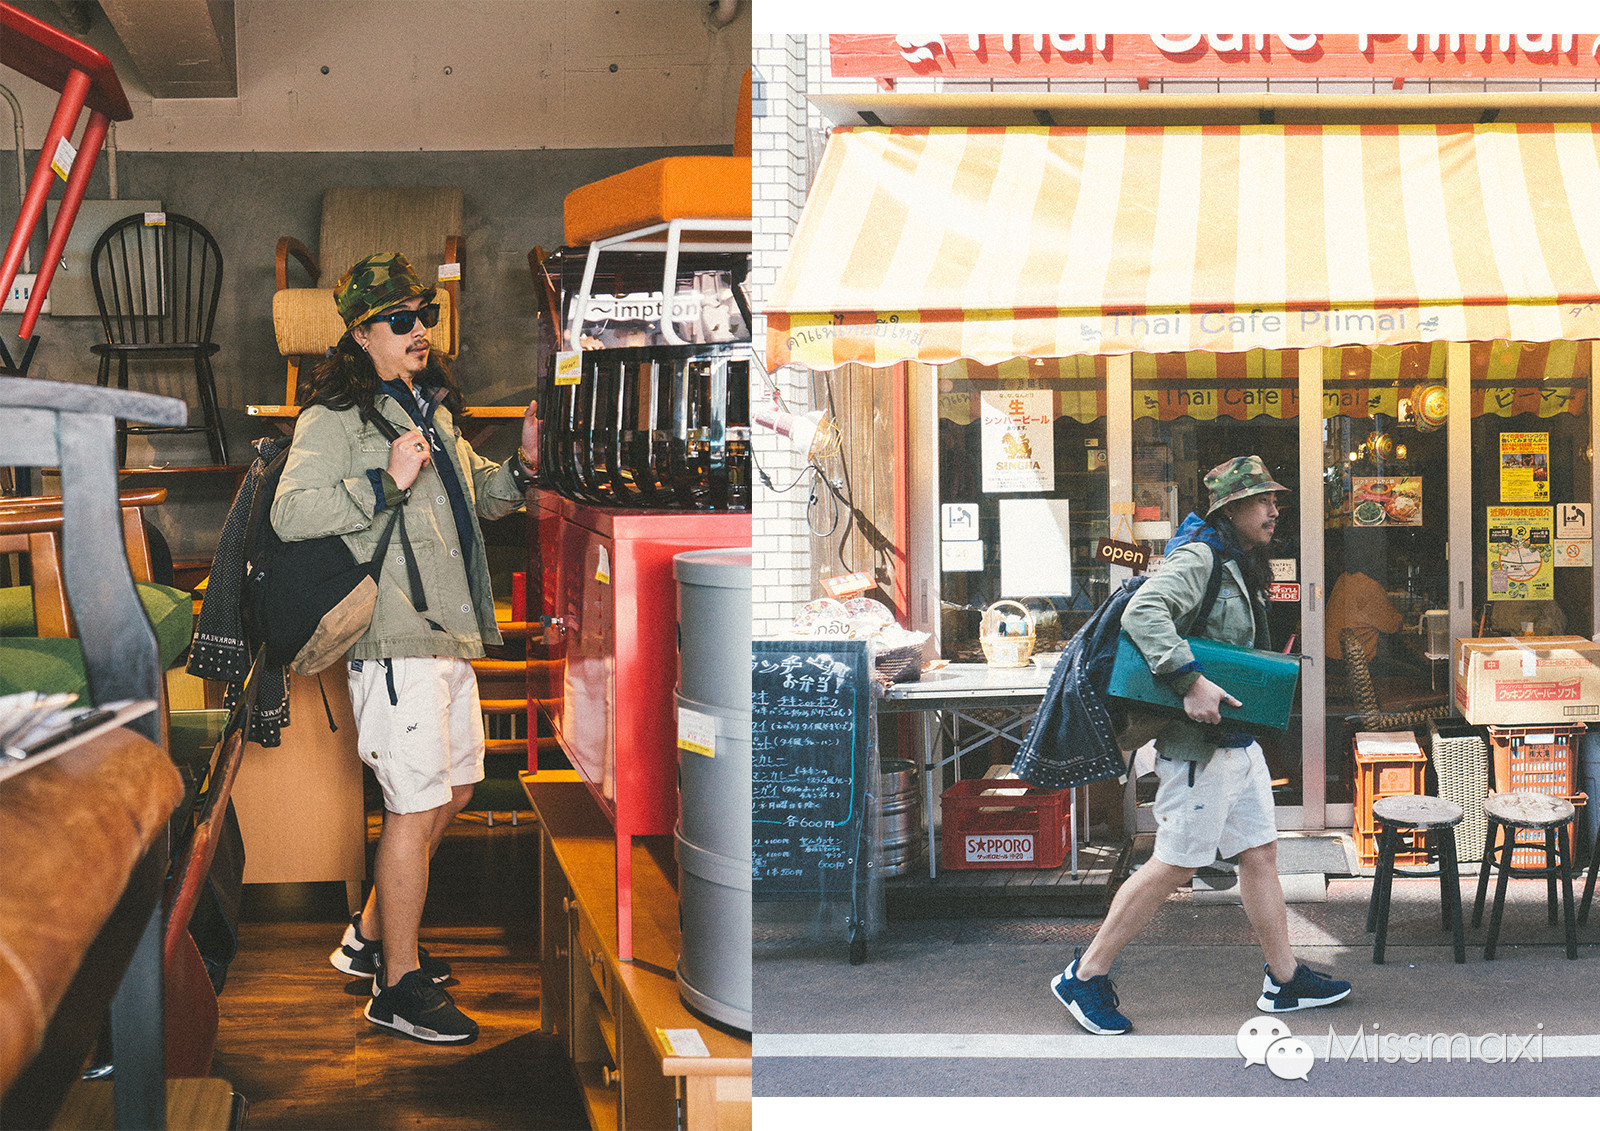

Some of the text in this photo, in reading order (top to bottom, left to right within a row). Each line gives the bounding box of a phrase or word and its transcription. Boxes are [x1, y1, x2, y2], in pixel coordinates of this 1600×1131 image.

[1106, 308, 1405, 336] Thai Cafe Piimai
[1223, 386, 1279, 406] Cafe
[1009, 399, 1025, 415] 生
[985, 415, 1050, 425] シンハービール
[996, 461, 1041, 471] SINGHA
[1102, 545, 1144, 564] open
[1499, 688, 1577, 699] クッキングペーパー ソフト
